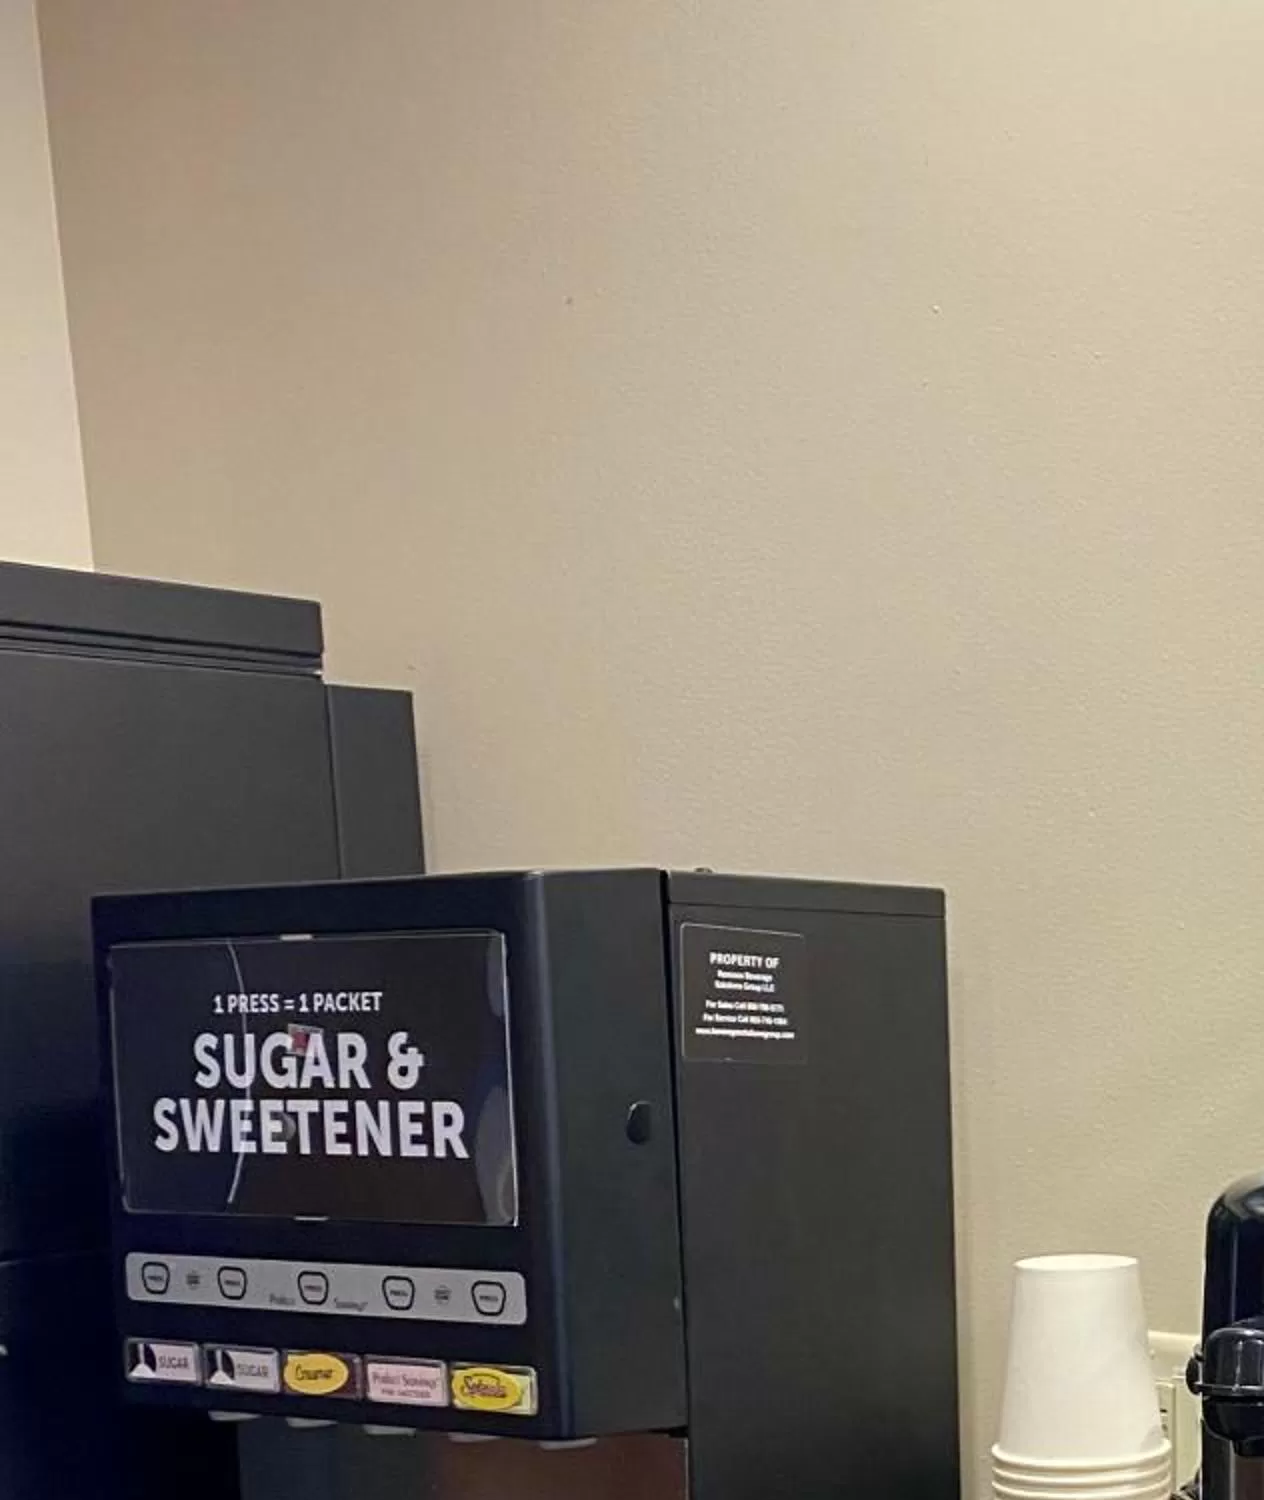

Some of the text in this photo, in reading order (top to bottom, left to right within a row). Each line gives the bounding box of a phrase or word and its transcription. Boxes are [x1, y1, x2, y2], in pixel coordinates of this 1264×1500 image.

[709, 952, 780, 969] PROPERTY OF
[214, 992, 383, 1013] 1 PRESS = 1 PACKET
[194, 1031, 424, 1091] SUGAR &
[153, 1097, 470, 1159] SWEETENER
[158, 1356, 189, 1369] SUGAR
[237, 1363, 269, 1377] SUGAR
